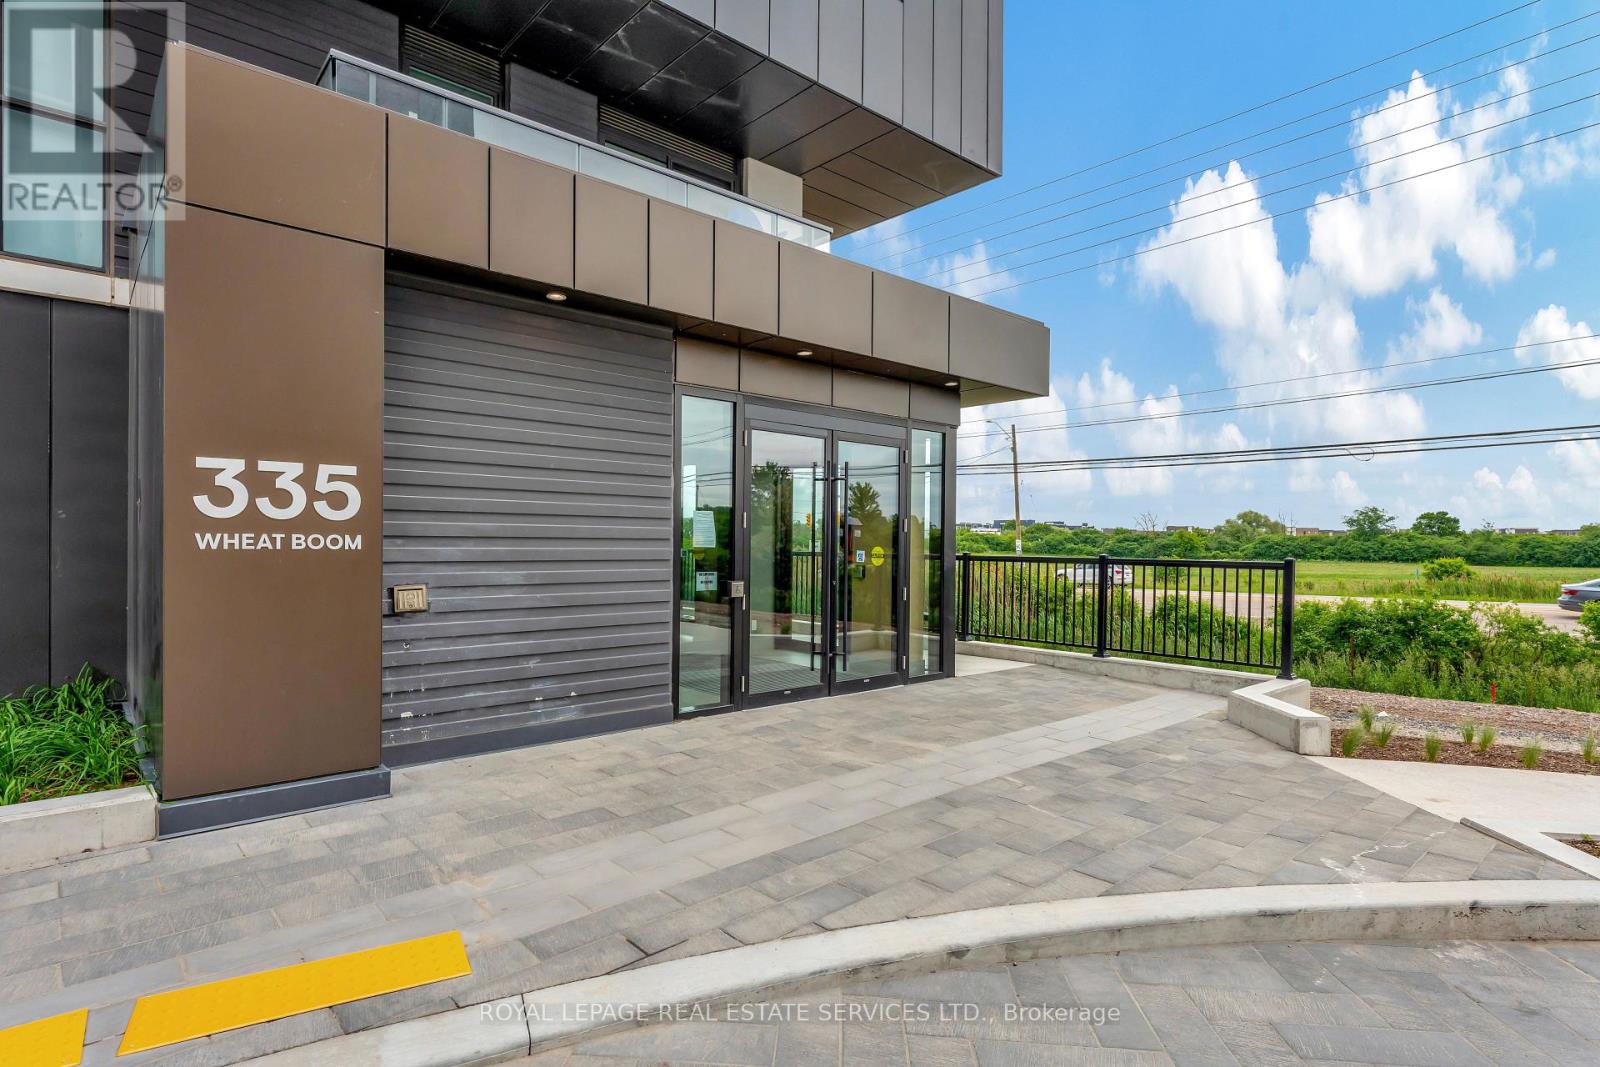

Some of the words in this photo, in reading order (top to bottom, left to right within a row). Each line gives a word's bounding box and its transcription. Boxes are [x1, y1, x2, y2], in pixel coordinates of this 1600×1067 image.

[192, 455, 362, 521] 335
[194, 532, 286, 550] WHEAT
[291, 533, 363, 550] BOOM
